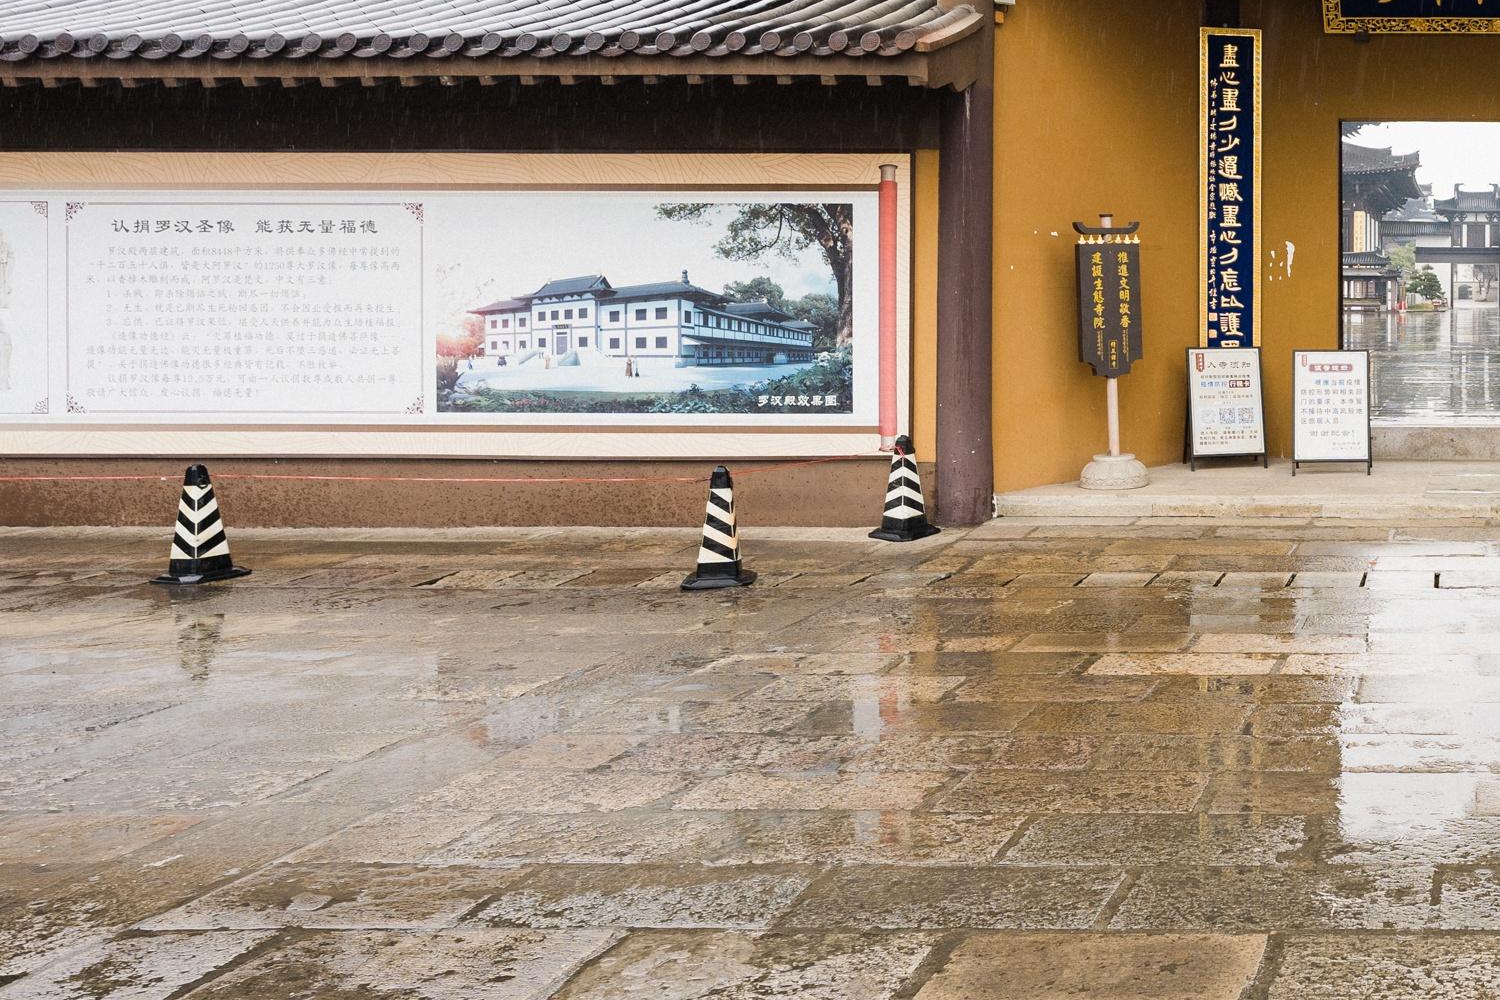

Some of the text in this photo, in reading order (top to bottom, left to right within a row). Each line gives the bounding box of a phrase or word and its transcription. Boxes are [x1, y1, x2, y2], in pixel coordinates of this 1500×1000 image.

[111, 219, 379, 234] 认捐罗汉圣像 能获无量福德
[757, 395, 837, 407] 罗汉殿效果图
